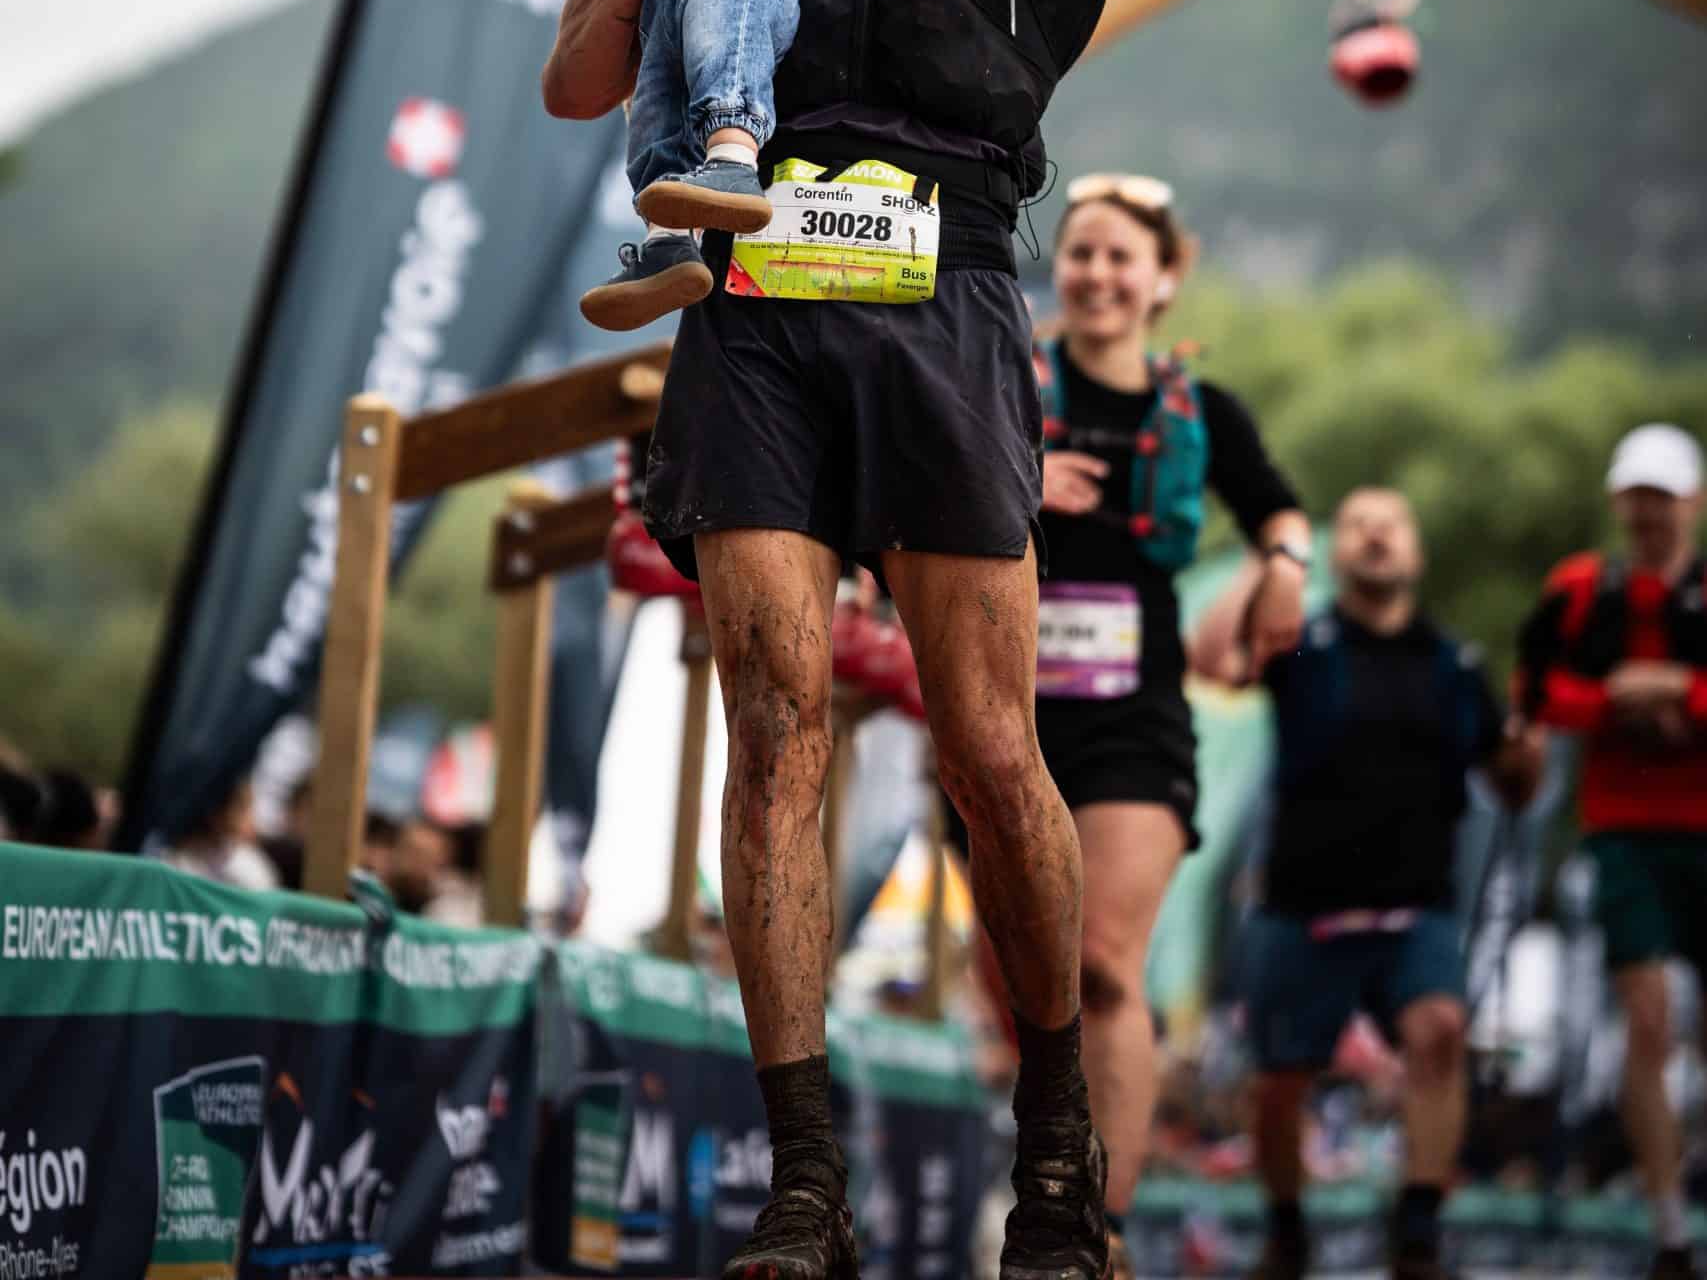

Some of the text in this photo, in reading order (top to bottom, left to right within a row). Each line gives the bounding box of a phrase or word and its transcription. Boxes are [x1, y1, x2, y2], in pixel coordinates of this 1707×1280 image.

[794, 187, 853, 202] Corentin
[881, 194, 936, 217] SHOKZ
[800, 209, 893, 242] 30028
[902, 267, 927, 280] Bus
